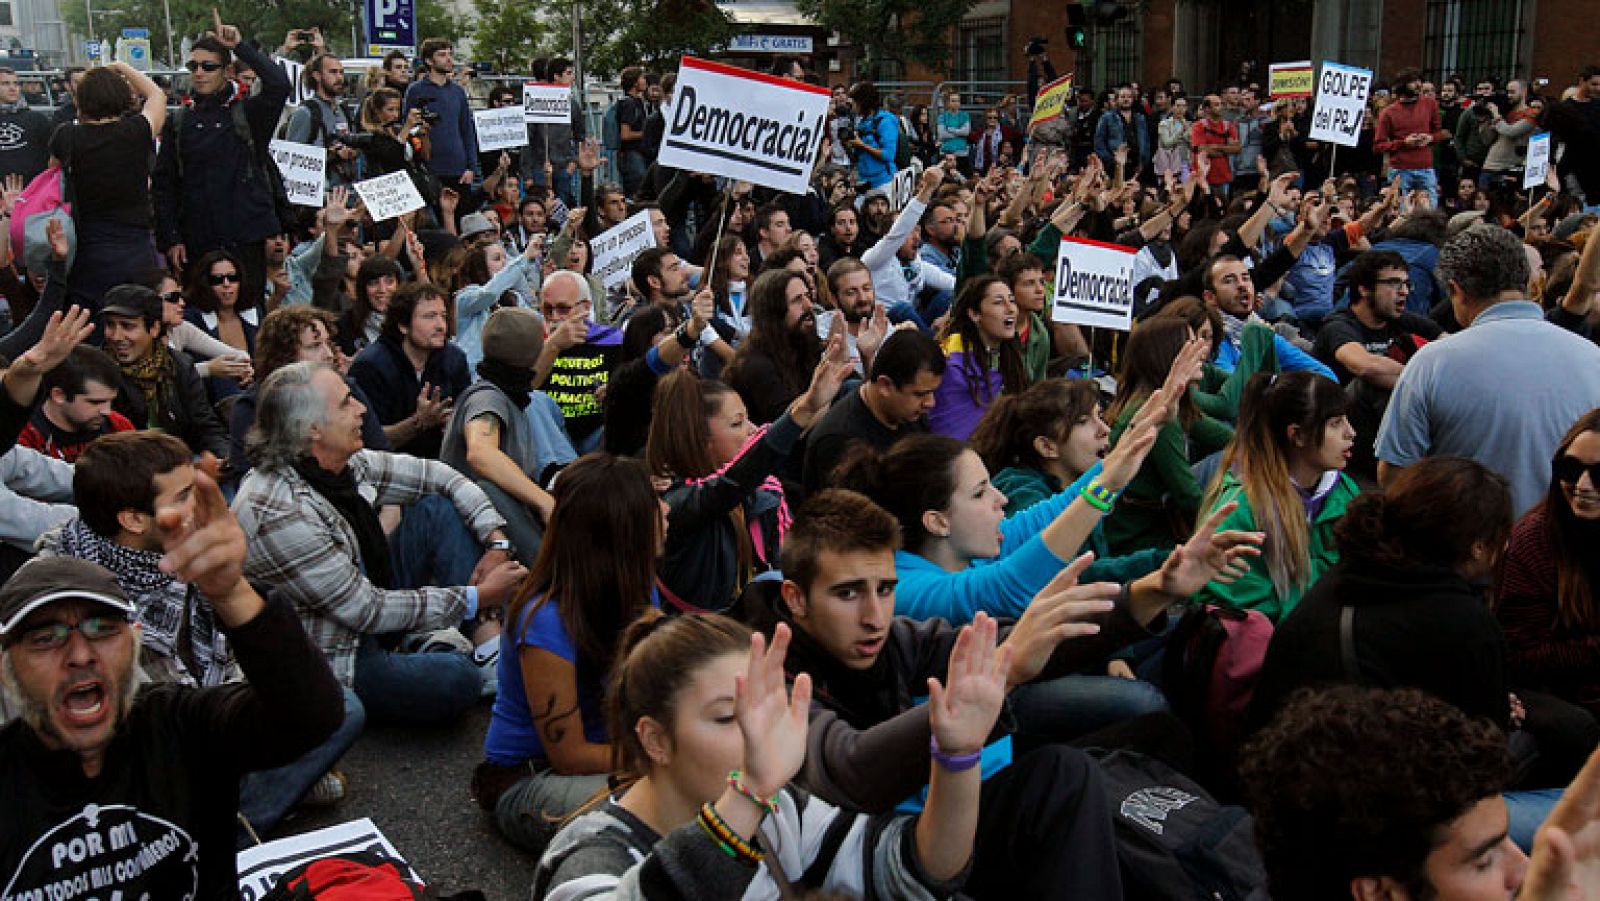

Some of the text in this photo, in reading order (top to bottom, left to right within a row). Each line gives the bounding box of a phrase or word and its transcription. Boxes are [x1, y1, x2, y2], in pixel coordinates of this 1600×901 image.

[772, 38, 807, 49] GRATIS
[1322, 70, 1368, 100] GOLPE
[671, 85, 825, 163] Democracia!
[1058, 255, 1134, 305] Democracia!
[52, 821, 138, 869] POR MI
